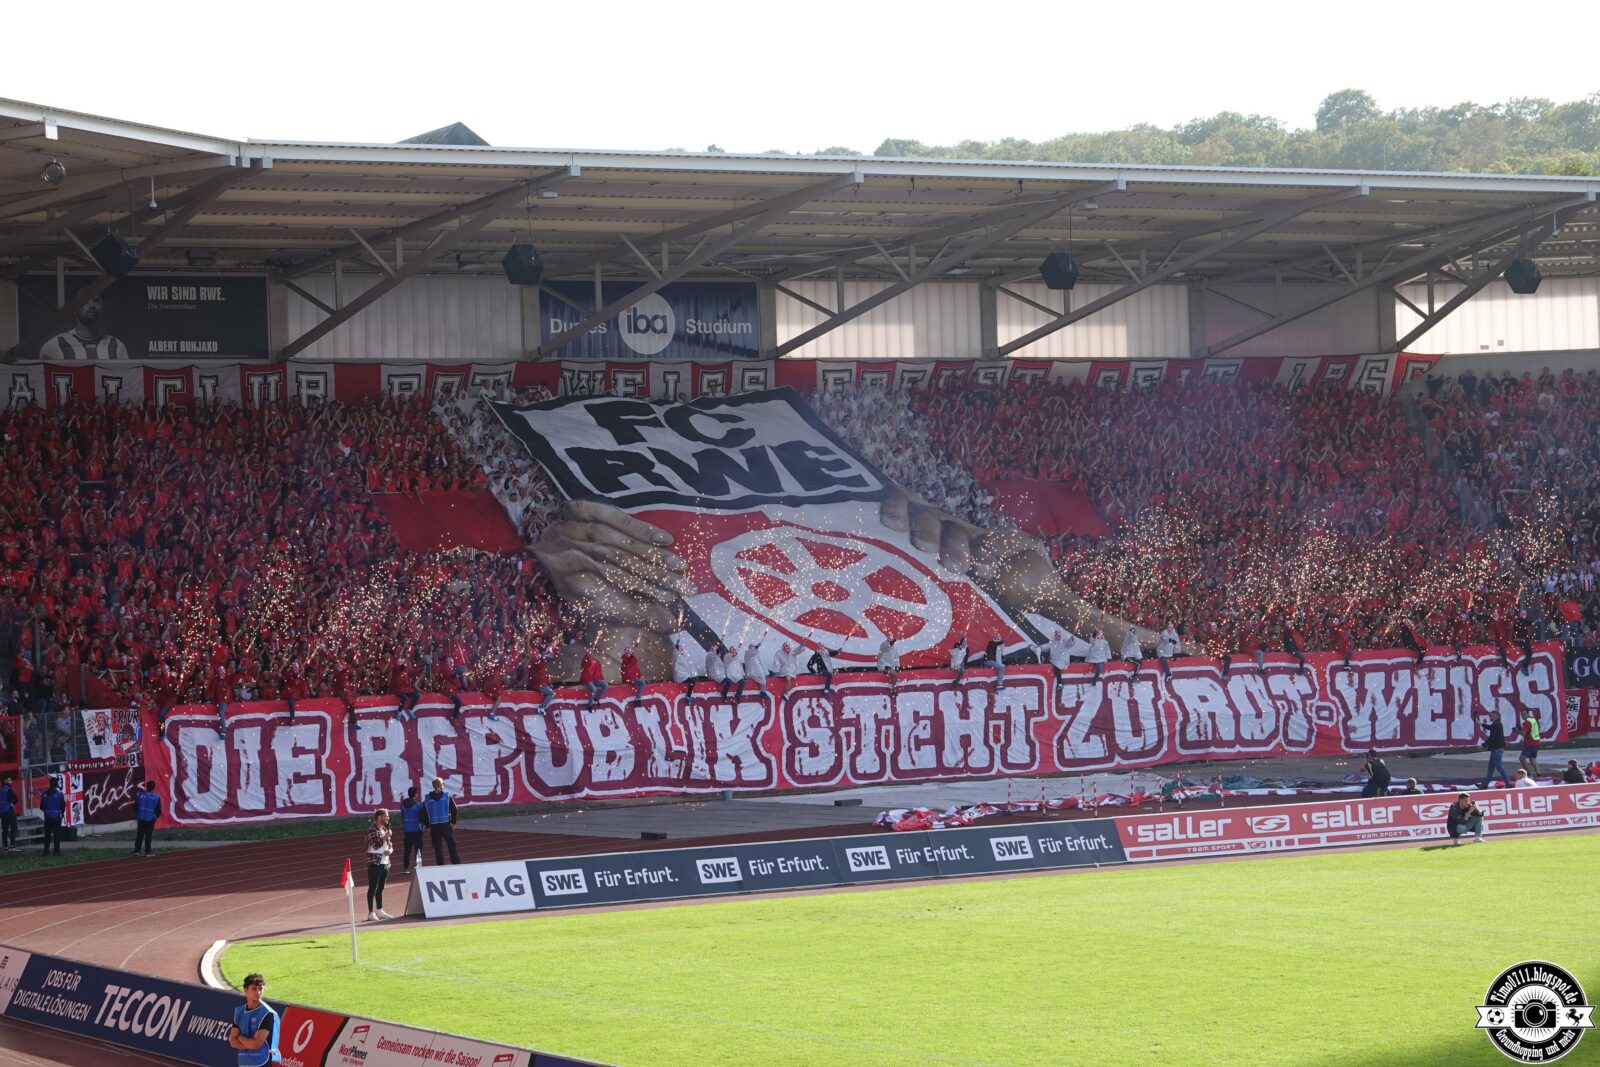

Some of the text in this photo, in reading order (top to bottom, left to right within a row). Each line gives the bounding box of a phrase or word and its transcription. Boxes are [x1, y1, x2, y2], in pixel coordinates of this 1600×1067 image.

[147, 285, 225, 302] WIR SIND RWE.
[550, 305, 752, 335] Dues iba Studium
[148, 340, 218, 353] ALBERT BUNJAKU
[583, 400, 755, 447] FC
[564, 441, 872, 497] RWE
[175, 722, 327, 814] DIE
[353, 700, 775, 808] REPUBLIK
[790, 684, 1042, 778] STEHT
[1058, 679, 1161, 762] ZU
[851, 844, 975, 868] SWE Für Erfurt.
[995, 833, 1113, 857] SWE Für Erfurt.
[545, 866, 679, 892] SWE Für Erfurt.
[702, 854, 830, 880] SWE Für Erfurt.
[426, 874, 526, 903] NT.AG
[41, 969, 82, 992] JOBS FÜR
[13, 989, 92, 1022] DIGITALE LÖSUNGEN
[94, 983, 191, 1042] TECCON
[376, 1036, 482, 1067] Gemeinsam rocken wir die Saison!
